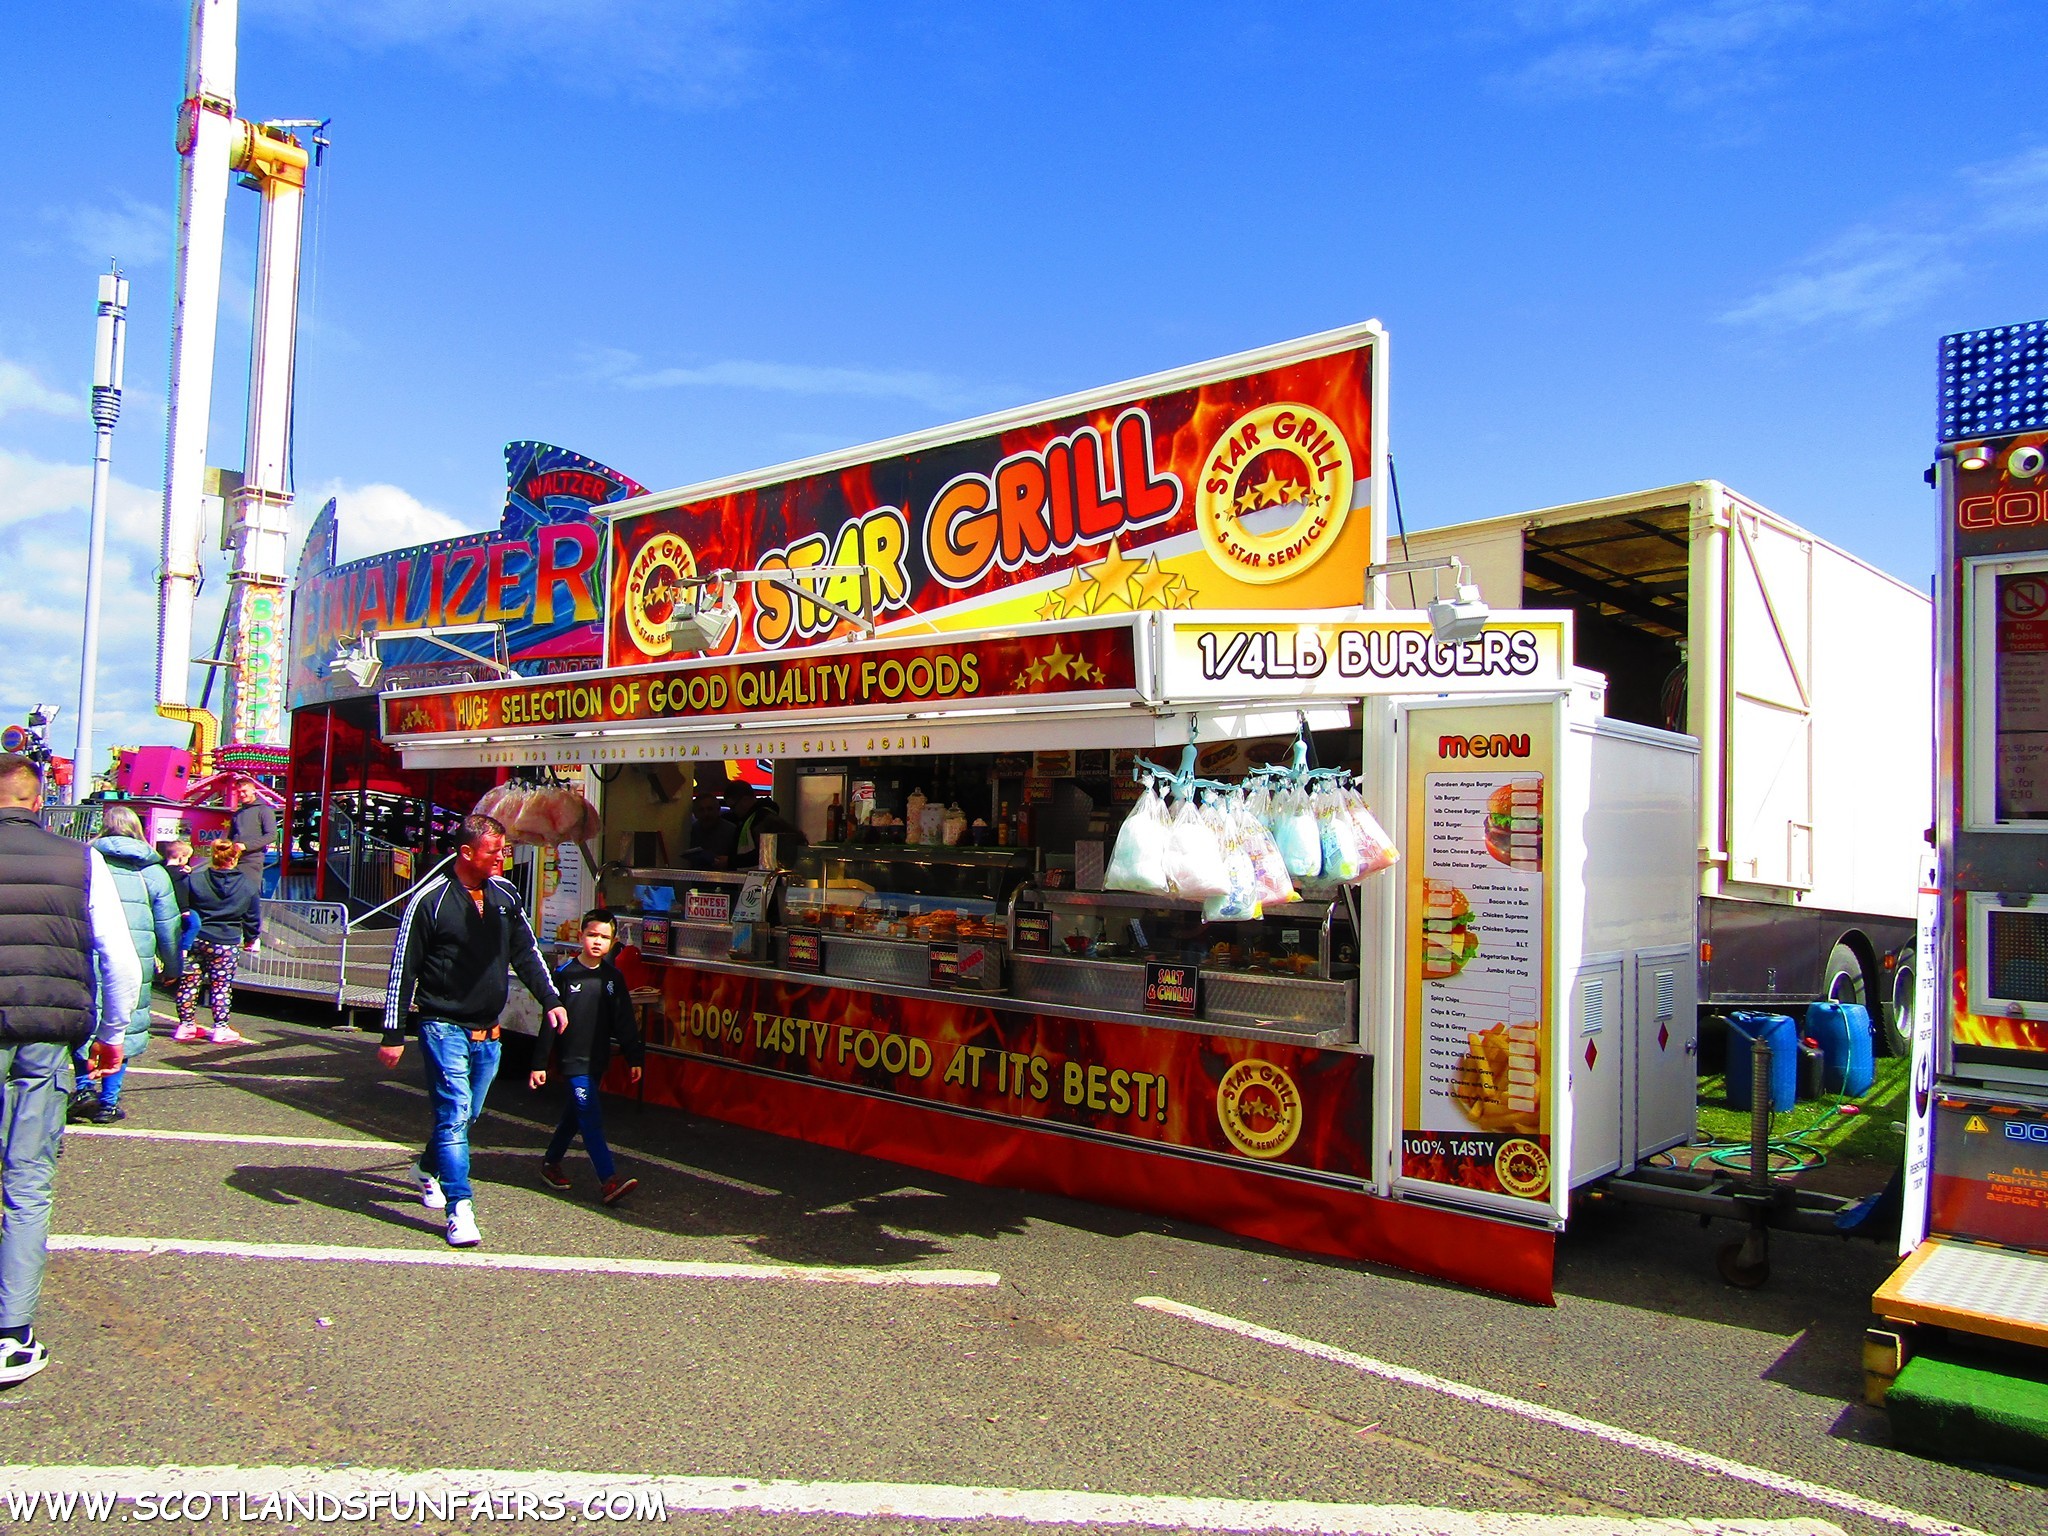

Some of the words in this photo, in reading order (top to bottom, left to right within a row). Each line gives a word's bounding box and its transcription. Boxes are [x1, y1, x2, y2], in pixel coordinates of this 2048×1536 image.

[1206, 423, 1260, 494] STAR
[1272, 412, 1342, 482] GRILL
[527, 471, 609, 501] WALTZER
[754, 506, 911, 650] STAR
[923, 407, 1184, 589] GRILL
[1217, 531, 1229, 544] 5
[1228, 543, 1261, 567] STAR
[1268, 516, 1327, 567] SERVICE
[630, 546, 657, 594] STAR
[661, 539, 694, 580] GRIL
[299, 523, 599, 659] EQUALIZER
[1198, 631, 1327, 679] 1/4LB
[1338, 630, 1538, 678] BURGERS
[457, 694, 488, 729] HUGE
[501, 686, 602, 724] SELECTION
[609, 682, 640, 715] OF
[648, 674, 728, 712] GOOD
[737, 664, 850, 706] QUALITY
[862, 653, 979, 699] FOODS
[557, 750, 580, 760] FOR
[592, 749, 626, 759] YOUR
[721, 741, 785, 755] PLEASE
[802, 738, 848, 752] CALL
[867, 735, 930, 750] AGAIN
[1438, 733, 1531, 759] menu
[199, 830, 223, 843] PAY
[689, 896, 726, 907] CHINESE
[310, 908, 329, 925] EXIT
[688, 907, 727, 918] NOODLES
[1158, 968, 1184, 985] SALT
[1147, 984, 1156, 999] &
[1157, 985, 1193, 1003] CHILLI
[1451, 1010, 1465, 1018] Curry
[678, 1000, 743, 1044] 100%
[753, 1011, 828, 1060] TASTY
[838, 1026, 932, 1077] FOOD
[943, 1046, 986, 1088] AT
[998, 1051, 1049, 1100] ITS
[1063, 1061, 1167, 1122] BEST!
[1430, 1048, 1444, 1056] Chips
[1223, 1065, 1253, 1101] STAR
[1259, 1064, 1297, 1111] GRILL
[1430, 1075, 1443, 1083] Chips
[1234, 1129, 1253, 1149] STAR
[1256, 1130, 1290, 1150] SERVICE
[1404, 1139, 1445, 1155] 100%
[1450, 1140, 1494, 1157] TASTY
[1499, 1142, 1519, 1163] STAR
[1523, 1143, 1548, 1171] GRILL
[2012, 1167, 2037, 1177] ALL
[1986, 1192, 2039, 1208] BEFORE
[1991, 1183, 2032, 1196] MUST
